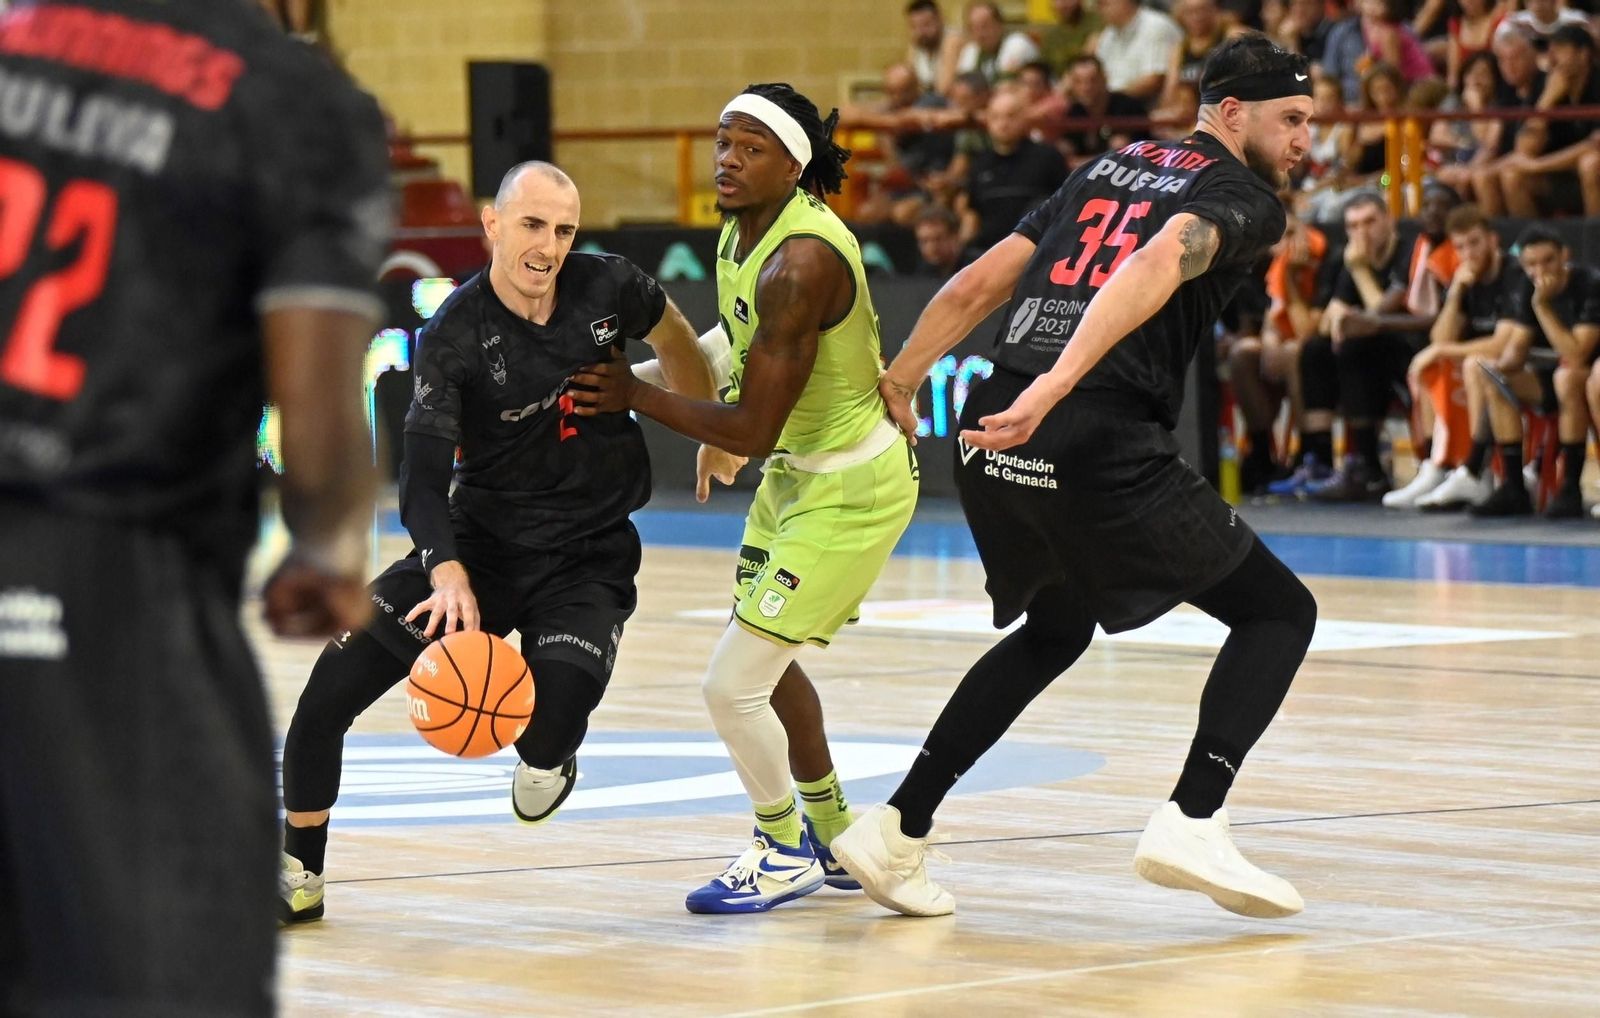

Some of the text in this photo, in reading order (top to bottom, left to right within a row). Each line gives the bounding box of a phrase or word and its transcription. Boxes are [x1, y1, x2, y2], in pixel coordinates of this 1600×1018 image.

[1050, 198, 1151, 288] 35
[1043, 299, 1087, 315] GRAN
[1036, 316, 1072, 335] 2031
[559, 394, 578, 442] 2
[985, 449, 1054, 474] Diputación
[984, 463, 1058, 489] de Granada
[776, 574, 792, 587] acb
[371, 594, 394, 613] vive
[546, 633, 603, 658] BERNER
